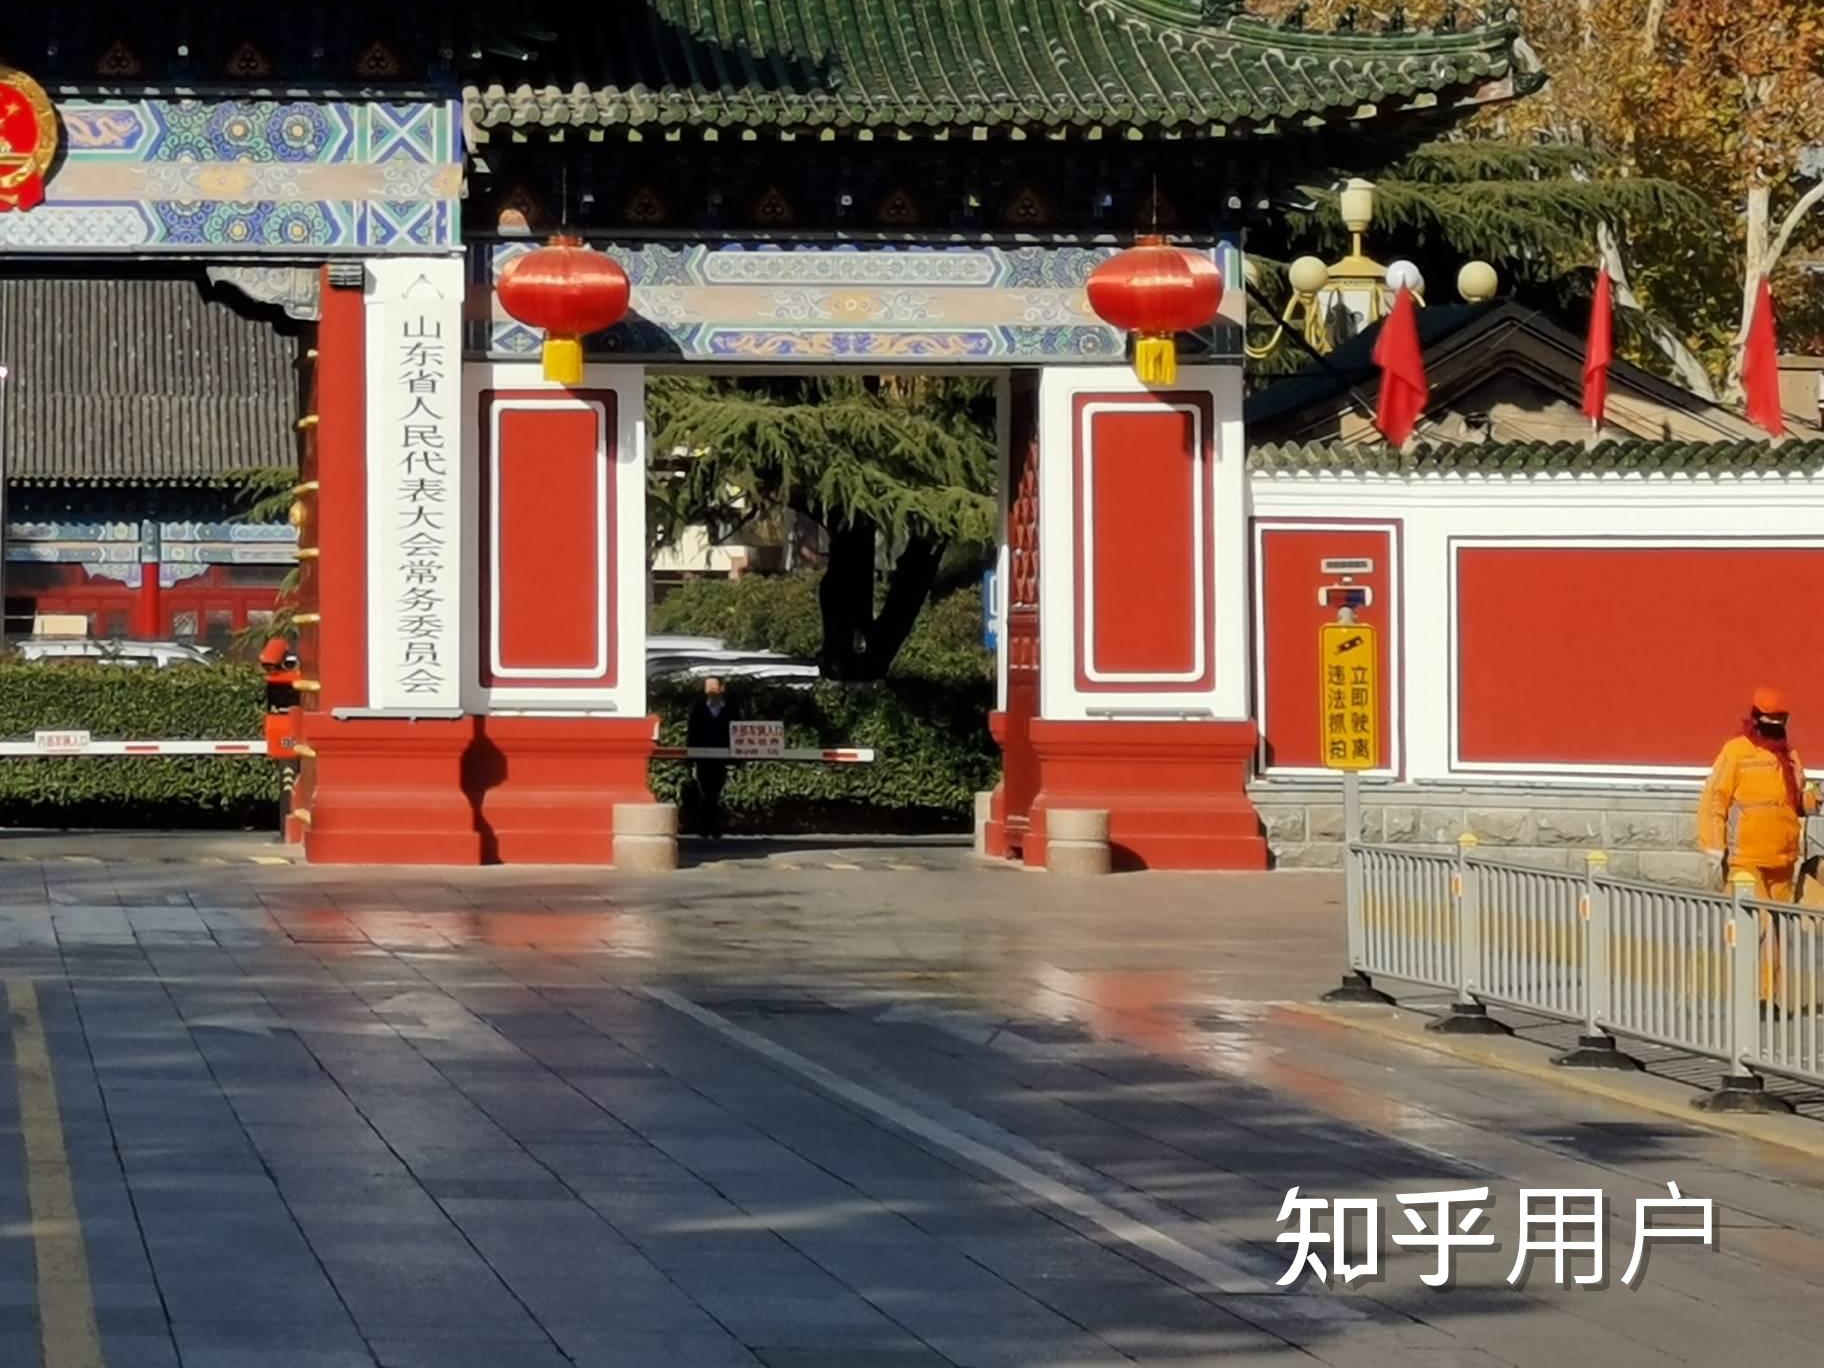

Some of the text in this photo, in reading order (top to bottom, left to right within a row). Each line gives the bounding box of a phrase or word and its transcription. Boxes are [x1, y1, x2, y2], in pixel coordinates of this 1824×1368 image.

[398, 315, 446, 694] 山东省人民代表大会常务委员会
[1328, 664, 1347, 760] 违法抓拍
[1351, 665, 1369, 760] 立即驶离
